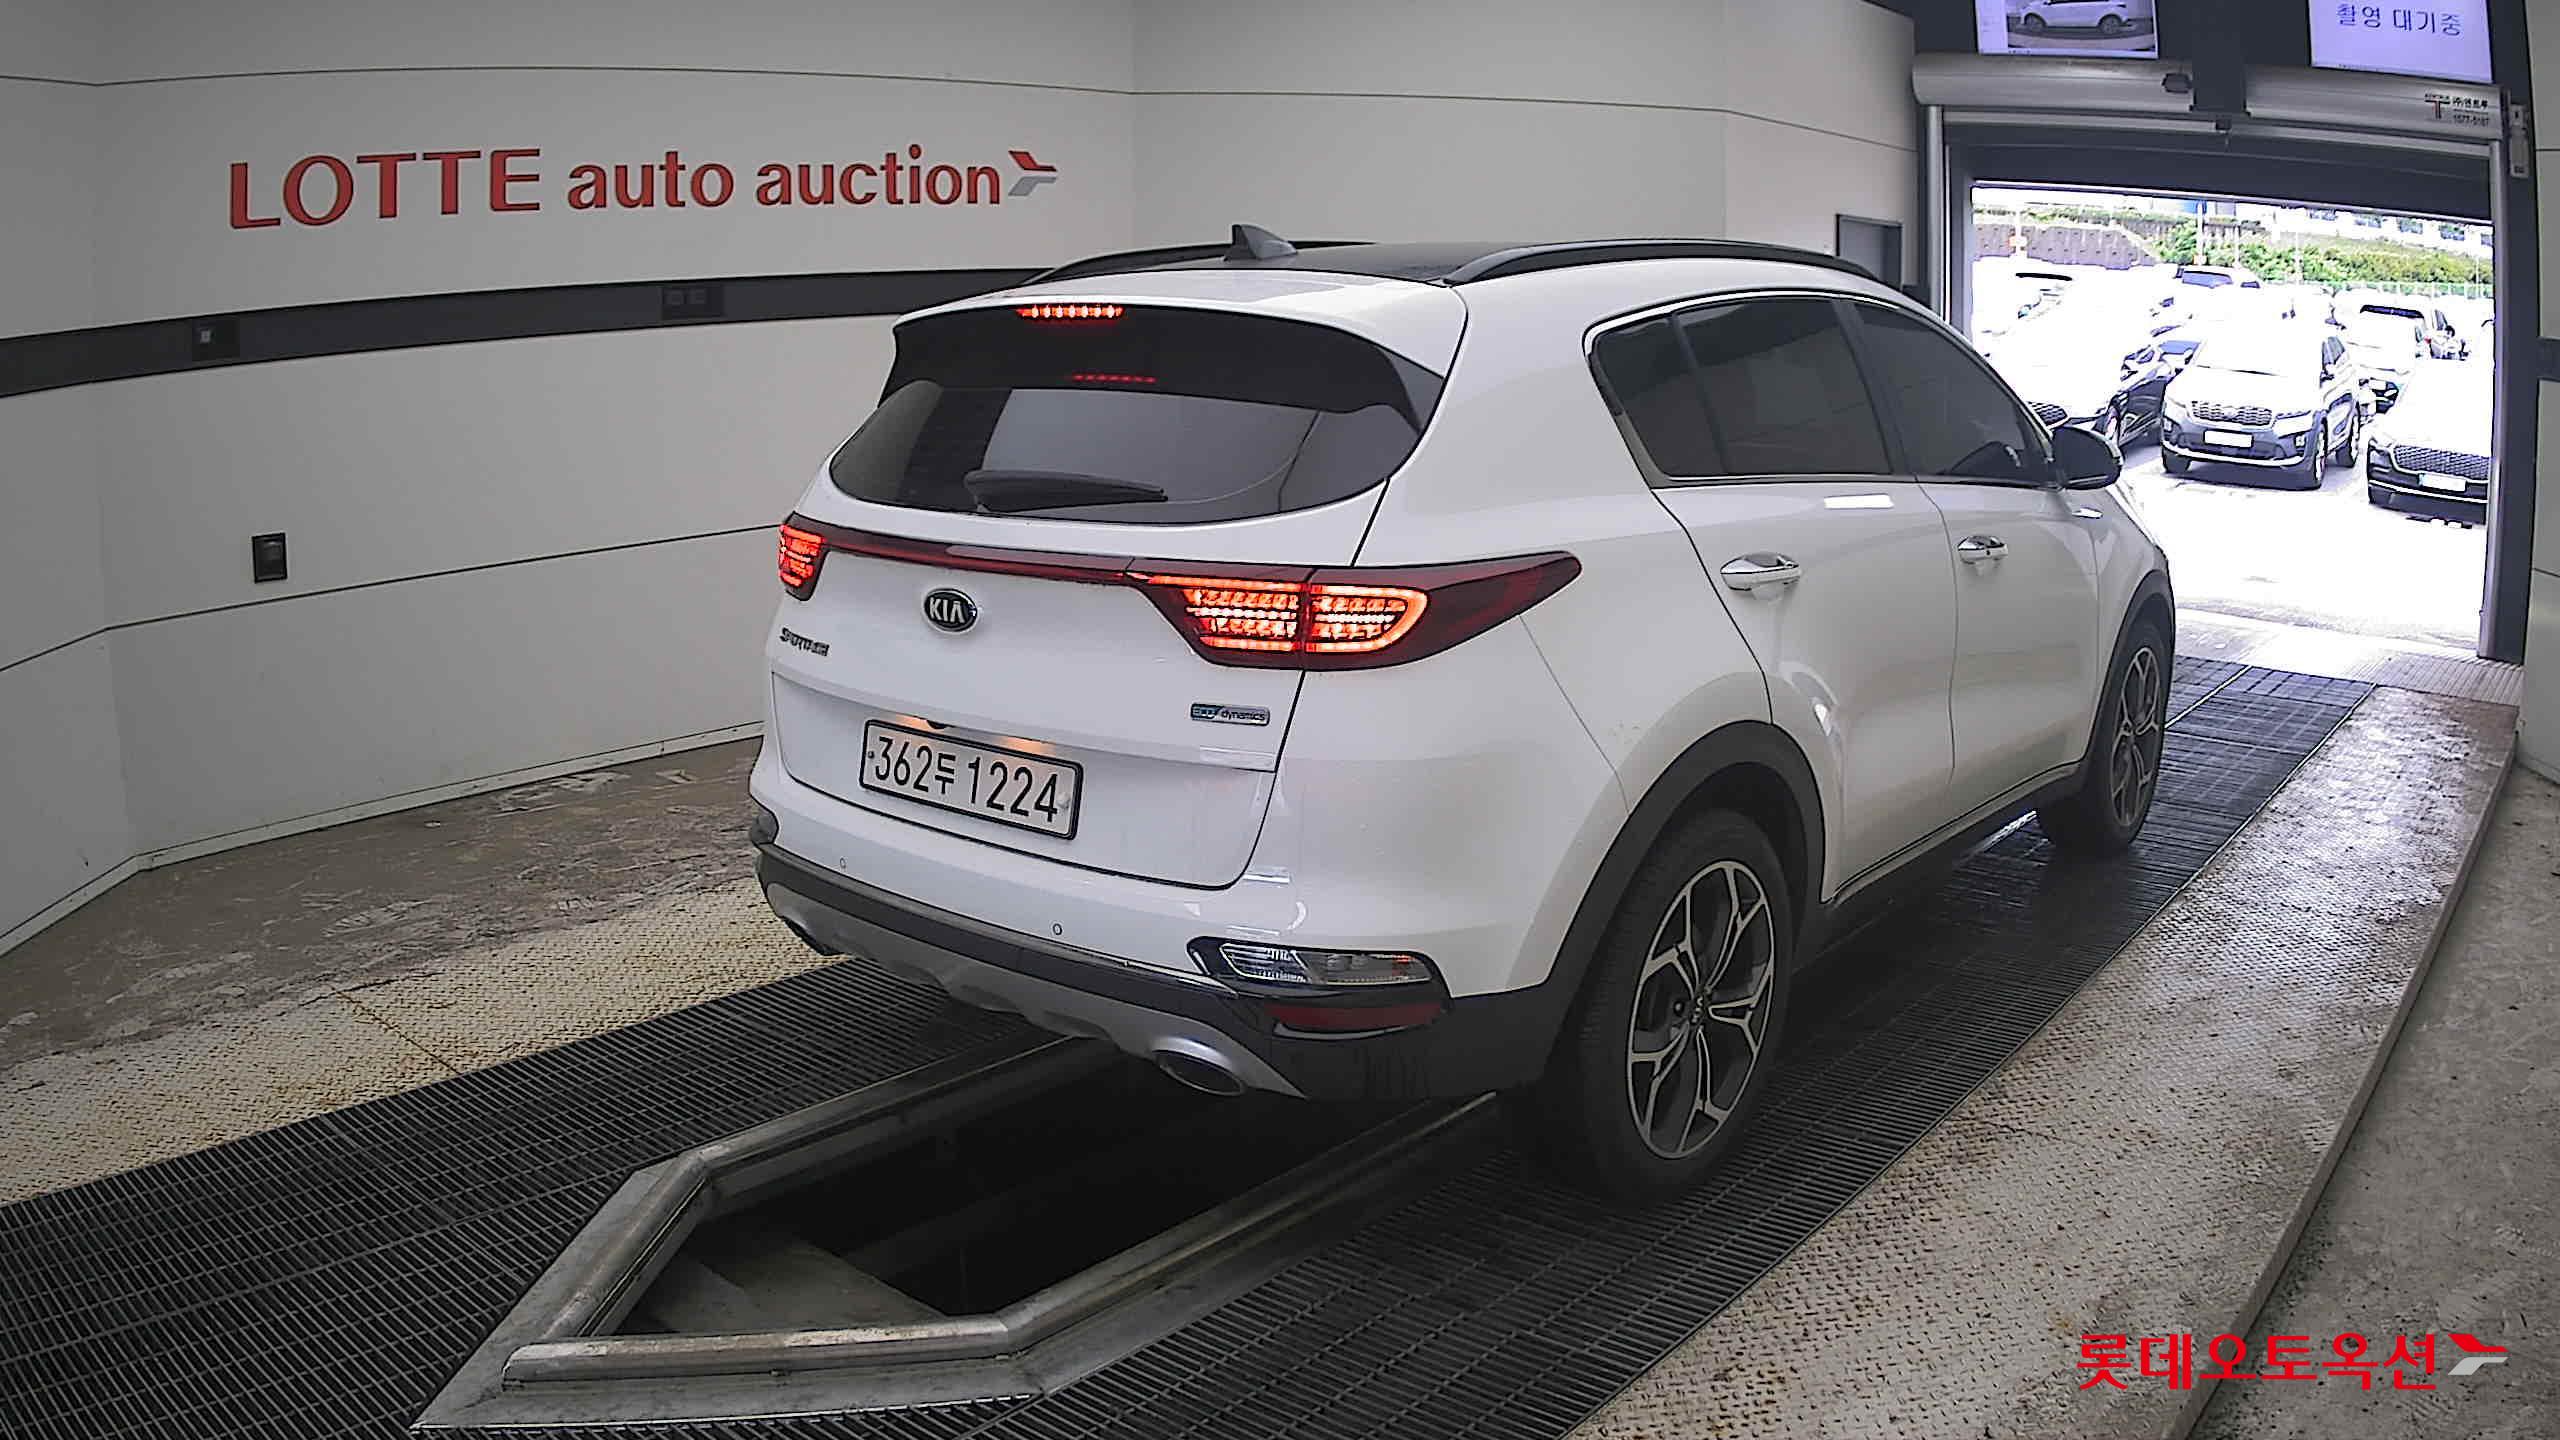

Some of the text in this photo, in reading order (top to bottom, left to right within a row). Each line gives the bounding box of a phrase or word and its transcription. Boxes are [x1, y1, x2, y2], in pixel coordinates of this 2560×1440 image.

[2337, 3, 2461, 37] 촬영 대기중
[230, 143, 1003, 229] LOTTE auto auction
[929, 597, 965, 624] KIA
[875, 736, 1059, 823] 362두 1224
